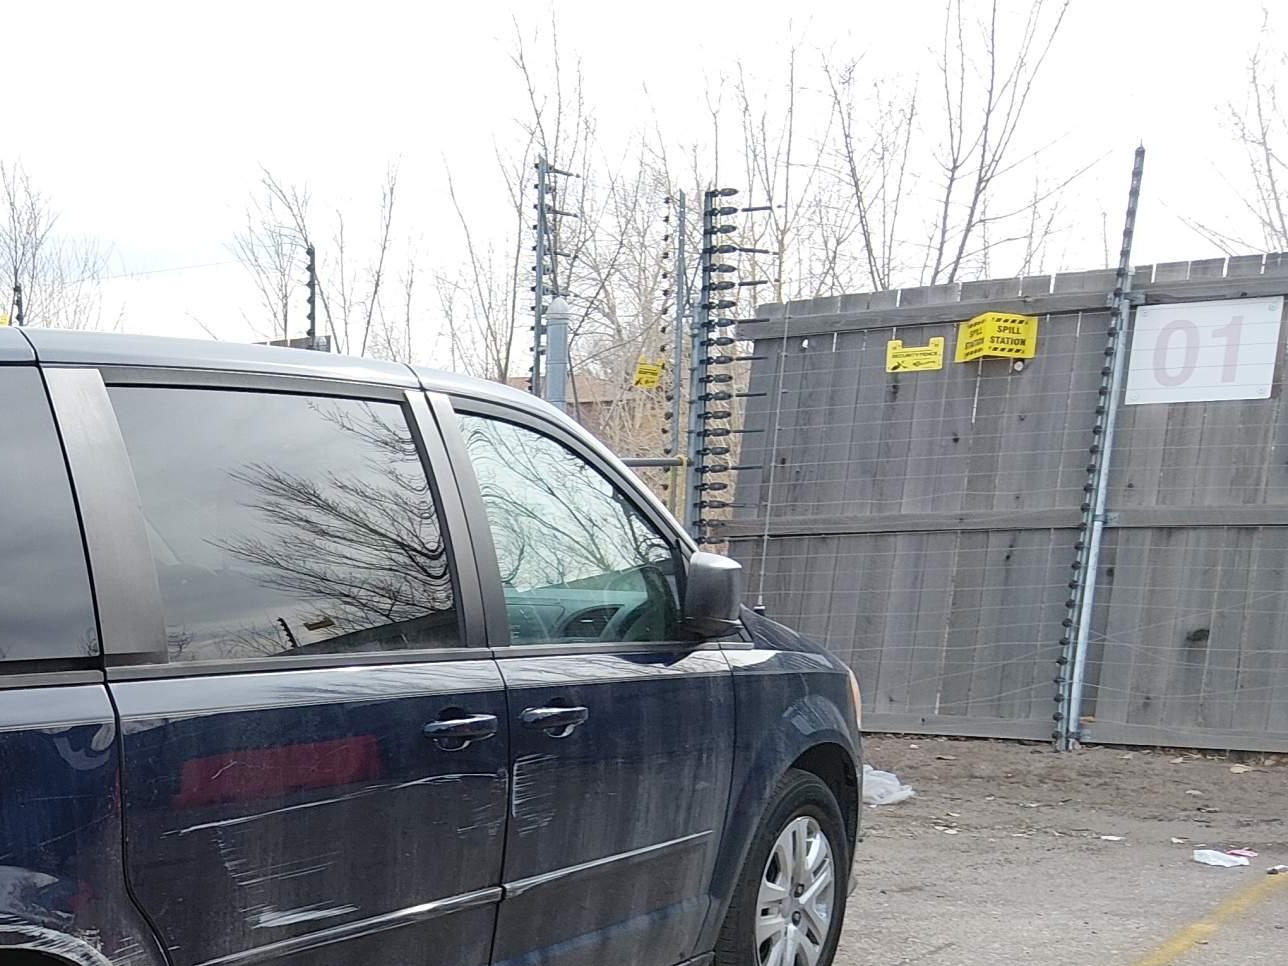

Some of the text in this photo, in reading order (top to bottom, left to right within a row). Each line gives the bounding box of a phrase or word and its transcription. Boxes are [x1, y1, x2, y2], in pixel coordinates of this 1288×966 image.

[996, 325, 1022, 335] SPILL
[989, 336, 1026, 346] STATION
[1153, 316, 1244, 386] 01
